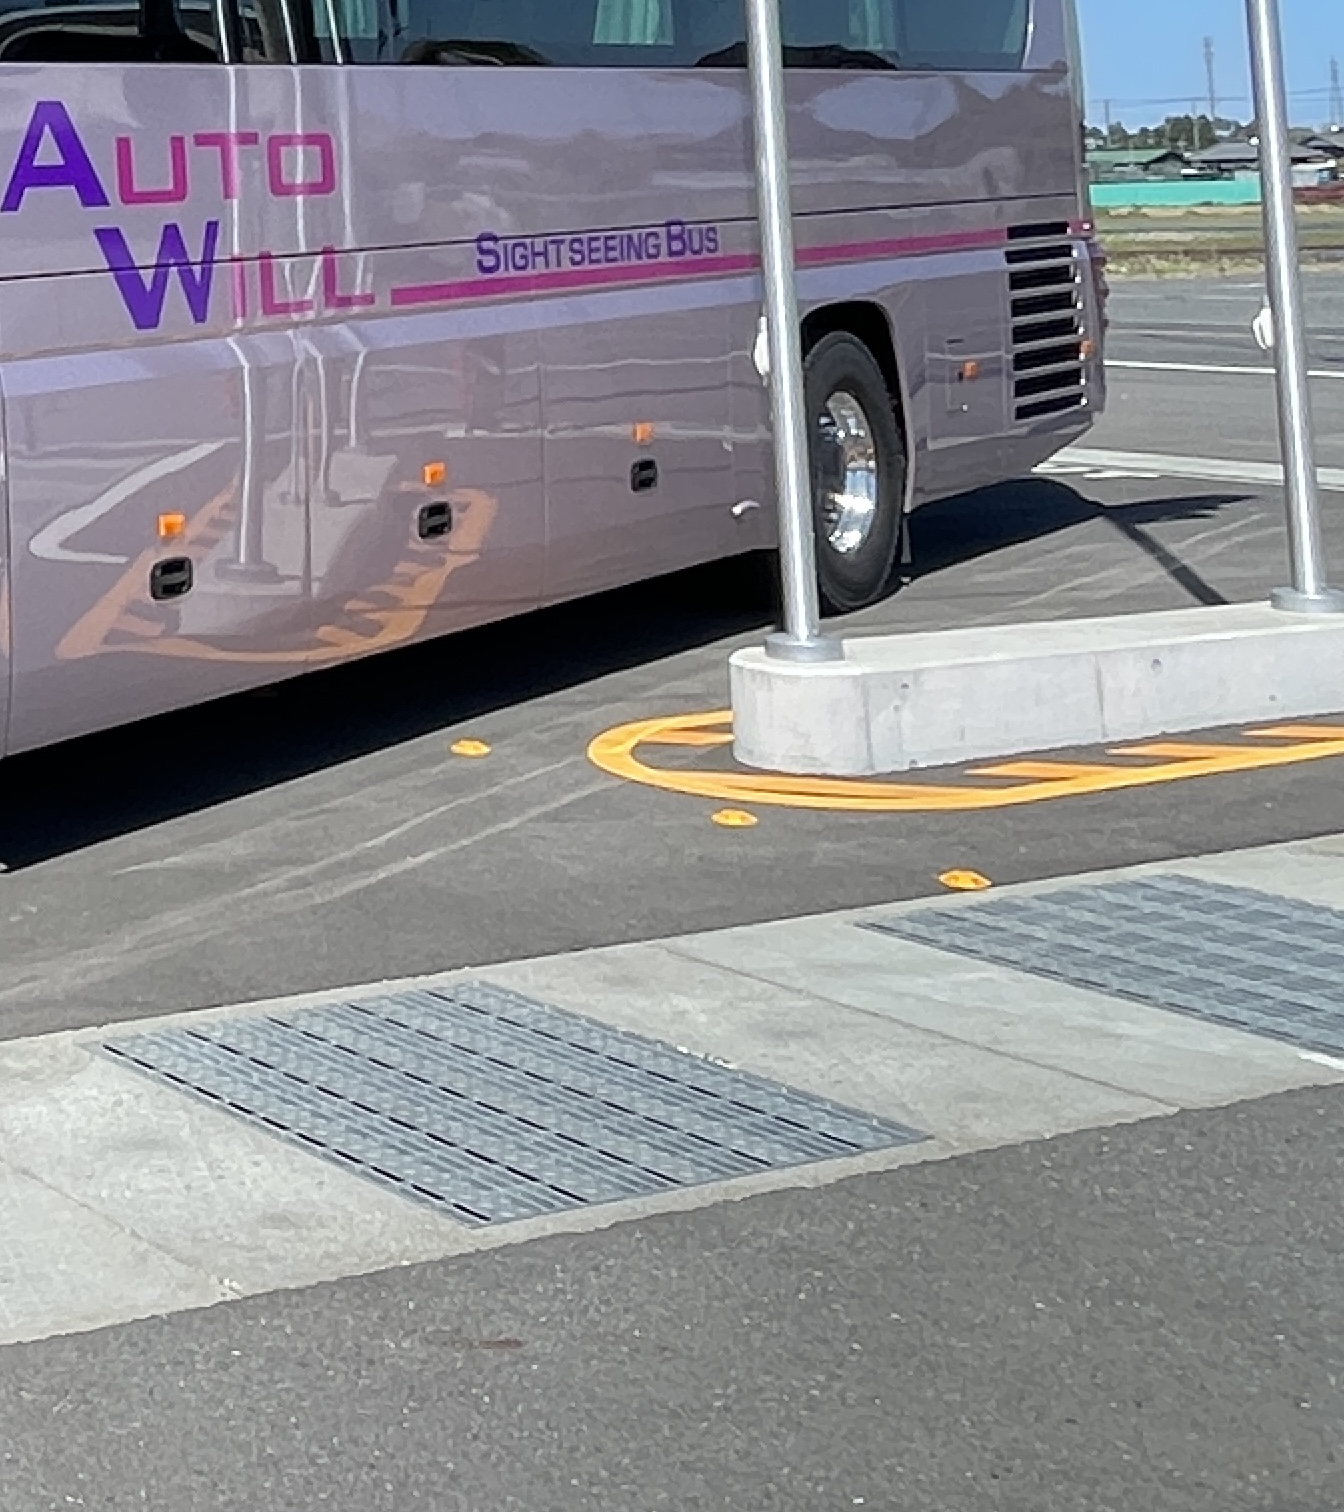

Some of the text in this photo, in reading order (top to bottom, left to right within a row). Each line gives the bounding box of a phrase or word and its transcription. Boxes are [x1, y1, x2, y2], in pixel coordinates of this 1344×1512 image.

[0, 100, 337, 214] AUTO
[92, 220, 376, 331] WILL
[476, 218, 719, 274] SIGHTSEEING BUS
